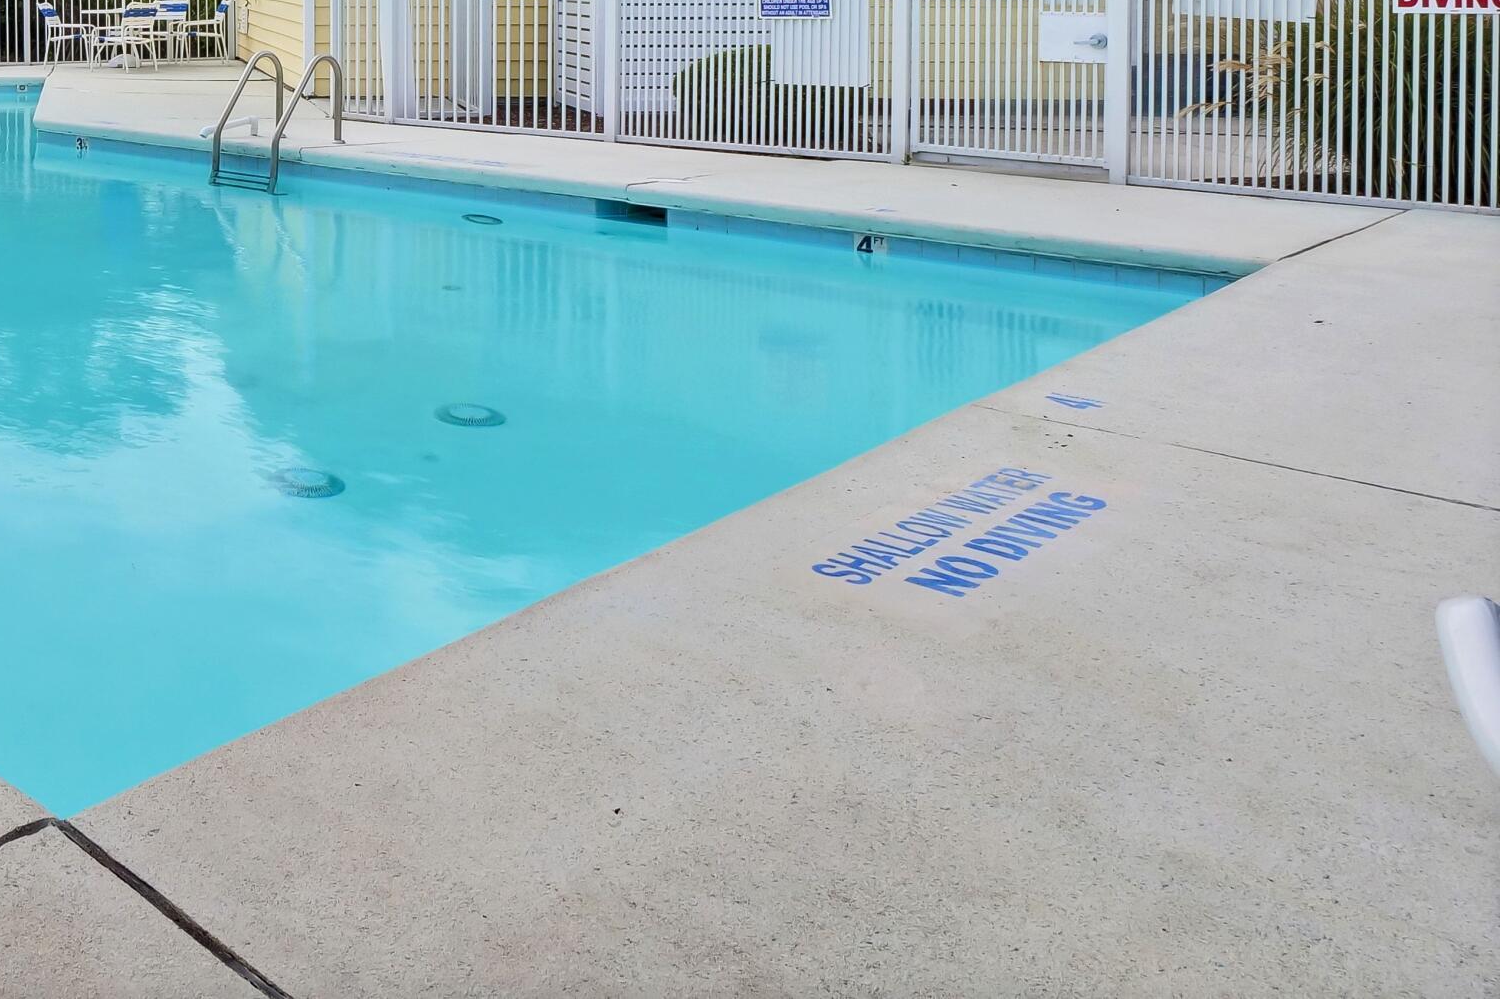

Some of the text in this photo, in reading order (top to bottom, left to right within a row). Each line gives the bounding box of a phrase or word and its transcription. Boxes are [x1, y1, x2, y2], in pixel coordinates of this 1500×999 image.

[857, 235, 885, 253] 4 FT
[811, 467, 1053, 586] SHALLOW WATER
[904, 491, 1108, 597] NO DIVING
